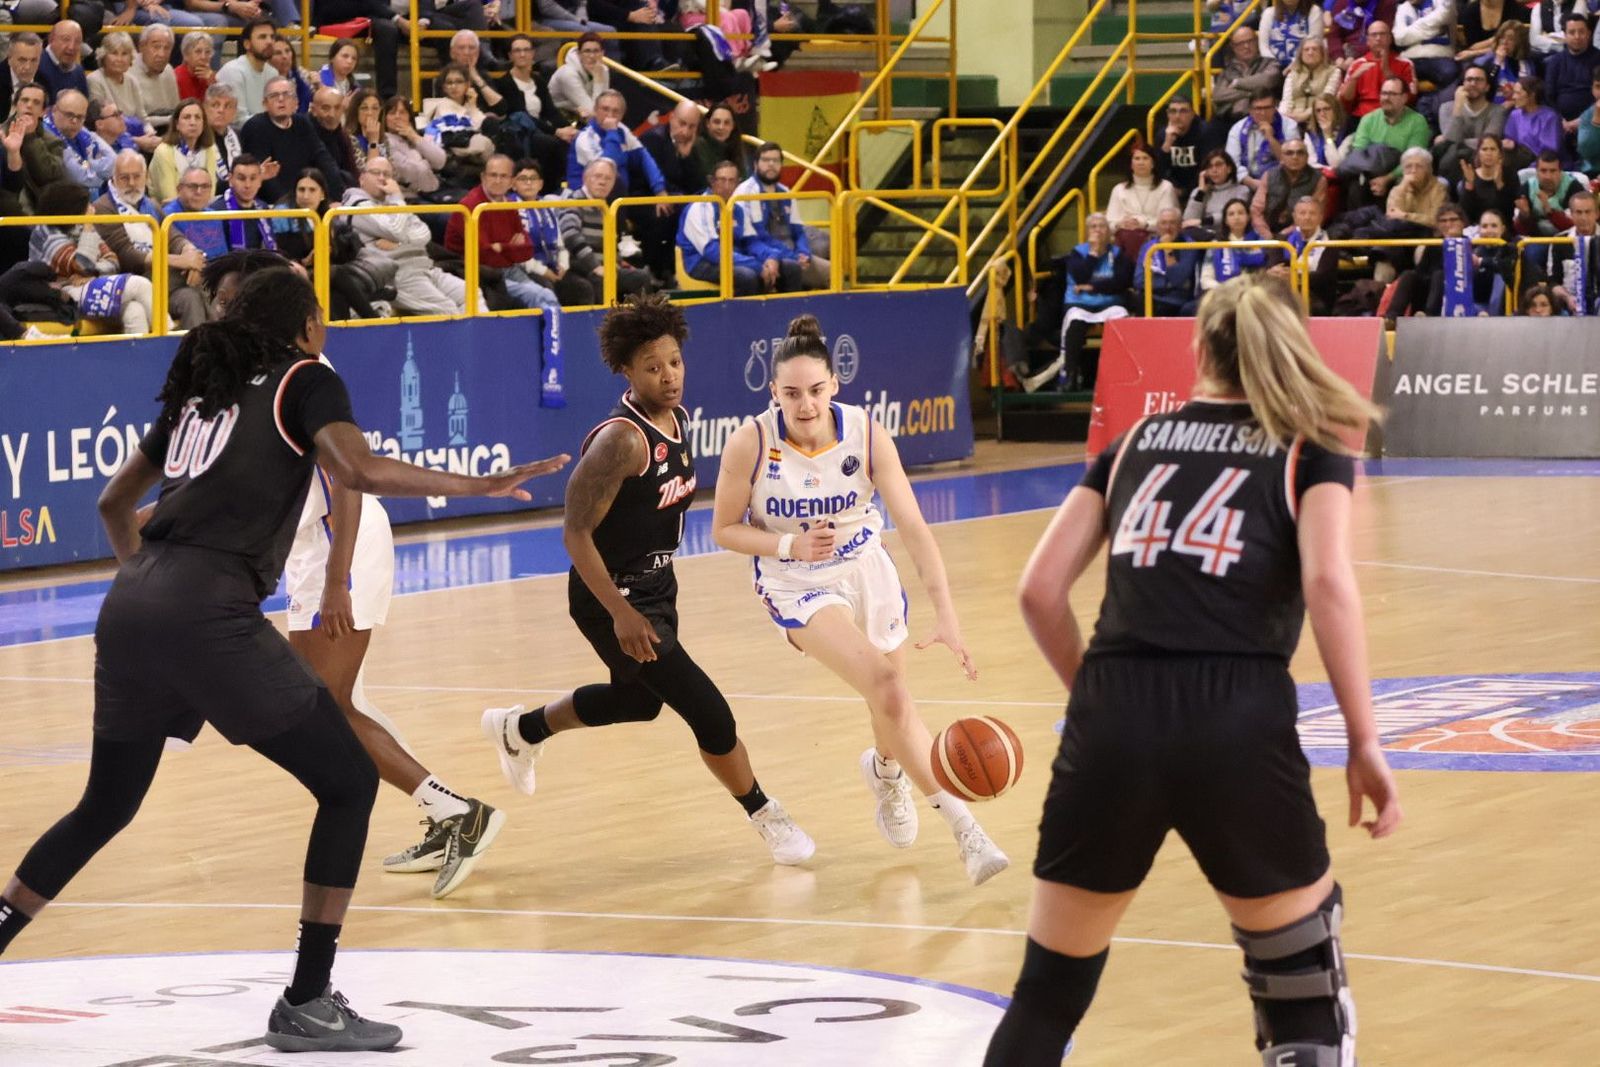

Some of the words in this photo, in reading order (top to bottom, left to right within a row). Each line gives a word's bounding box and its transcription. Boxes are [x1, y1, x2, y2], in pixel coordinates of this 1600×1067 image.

[1395, 374, 1489, 395] ANGEL
[1480, 405, 1588, 416] PARFUMS
[164, 396, 240, 479] 00
[1137, 420, 1280, 458] SAMUELSON
[1, 432, 30, 499] Y
[766, 490, 858, 519] AVENIDA
[1111, 463, 1252, 577] 44
